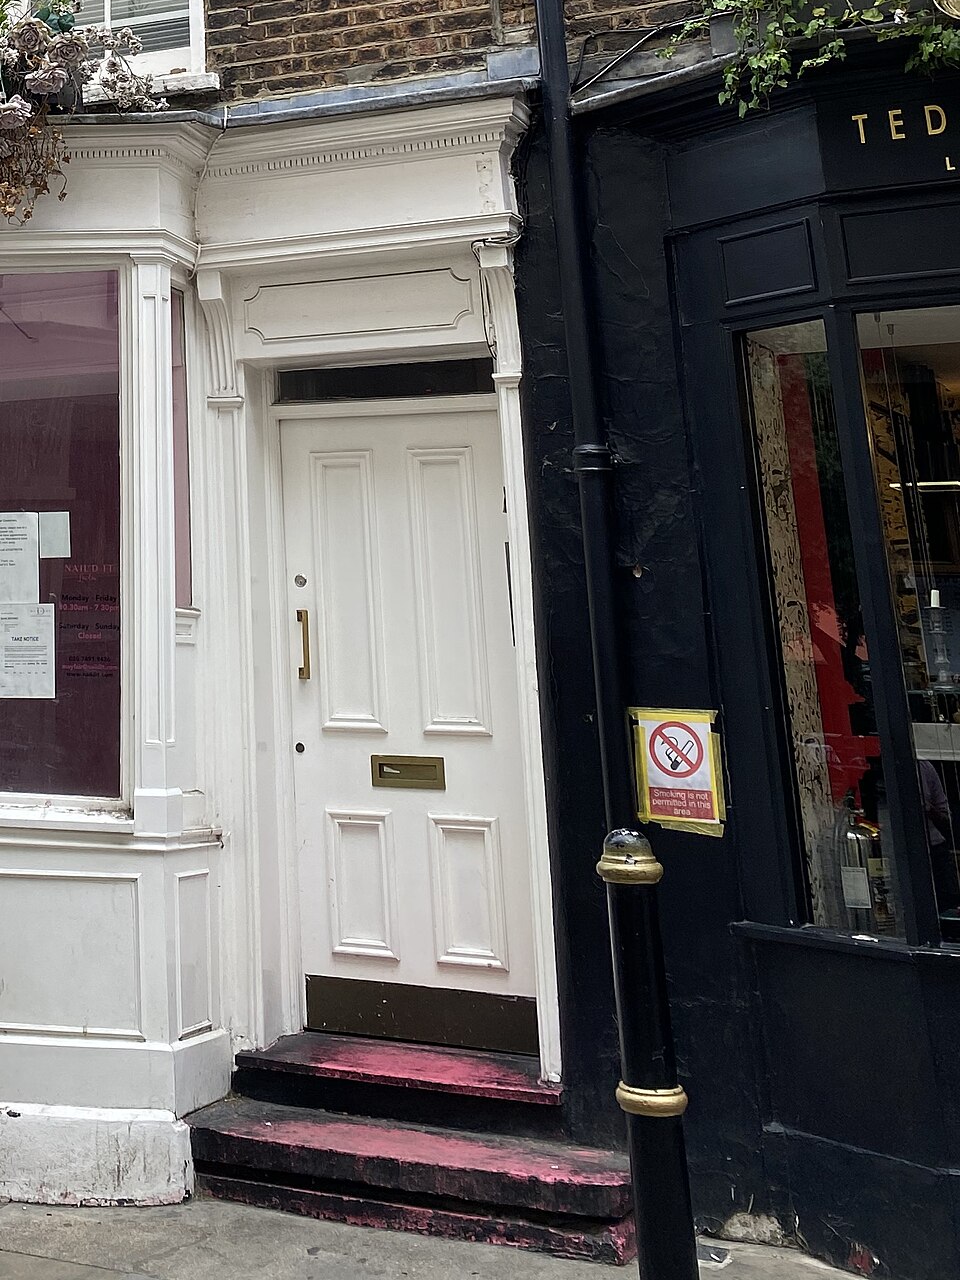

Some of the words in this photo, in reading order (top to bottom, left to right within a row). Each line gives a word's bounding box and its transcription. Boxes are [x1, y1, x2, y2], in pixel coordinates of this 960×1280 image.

[851, 104, 947, 144] TED
[61, 594, 89, 602] Monday
[95, 594, 118, 602] Friday
[59, 622, 89, 631] Saturday
[653, 789, 686, 800] Smoking
[687, 791, 695, 799] is
[695, 792, 708, 801] not
[652, 799, 687, 807] permitted
[688, 800, 696, 808] in
[697, 800, 711, 809] this
[673, 808, 691, 816] area
